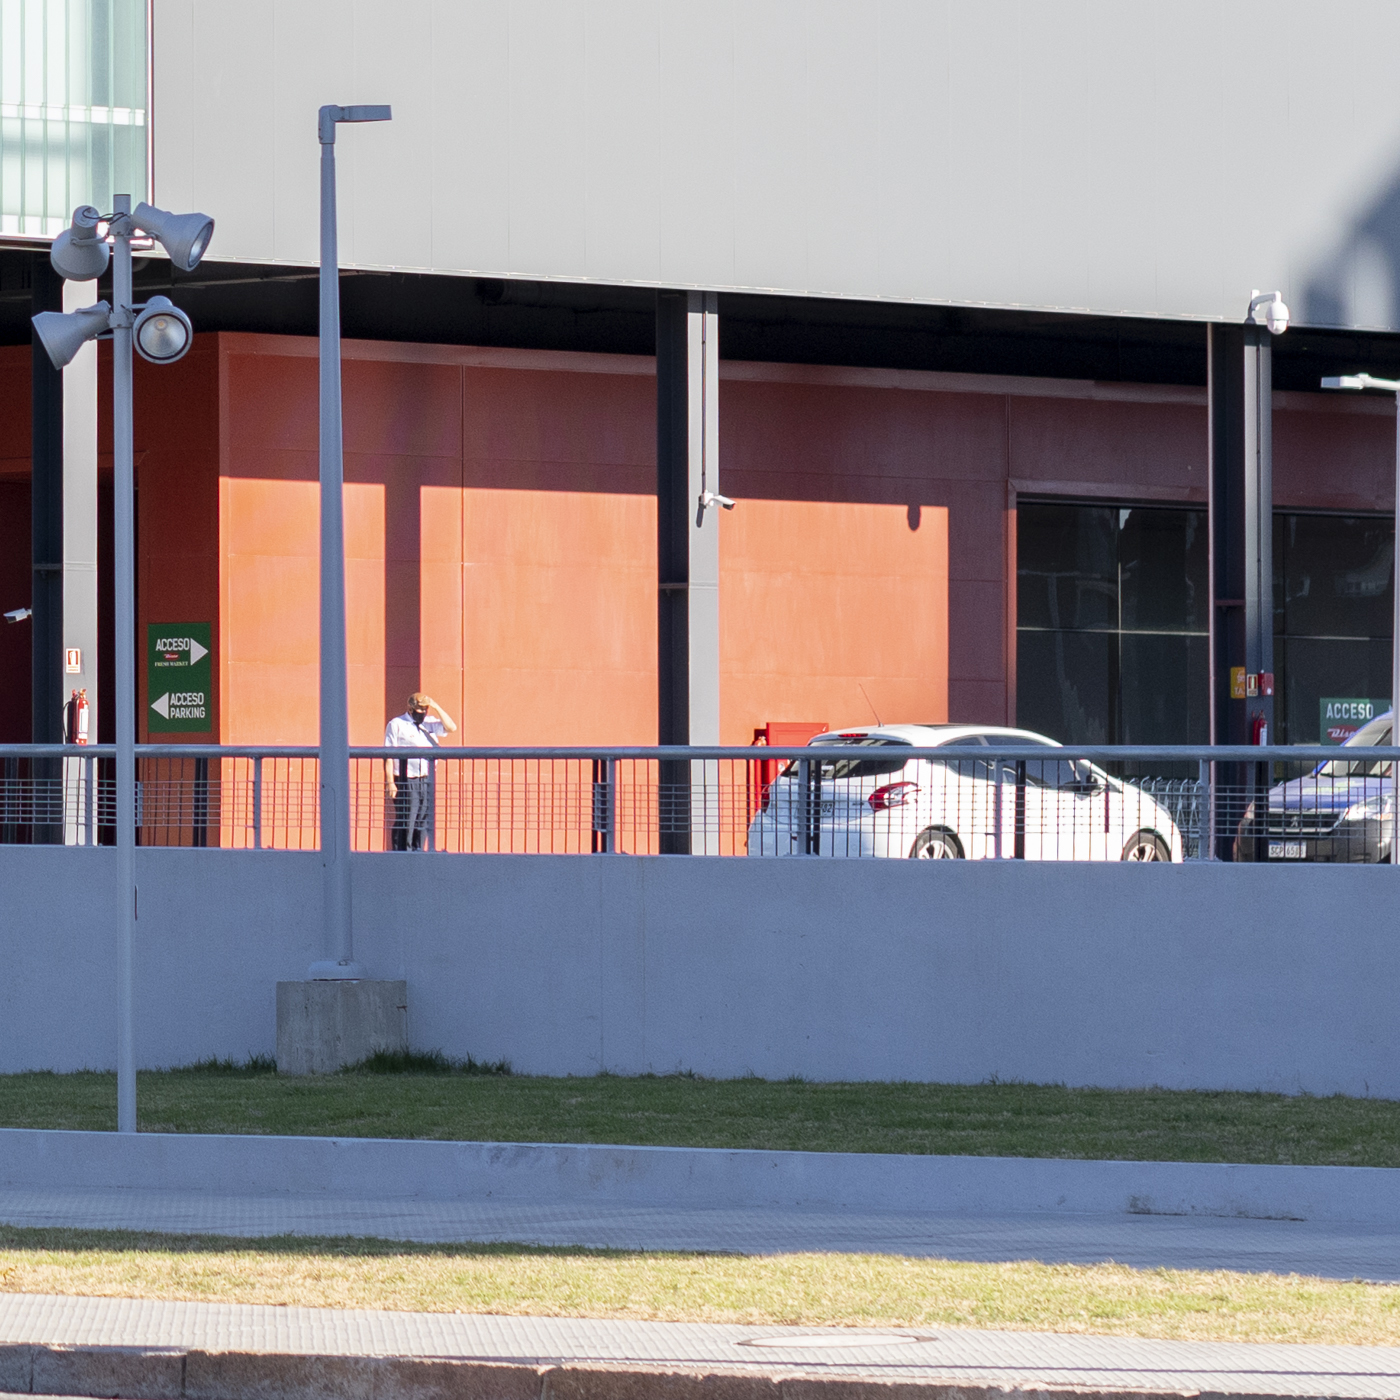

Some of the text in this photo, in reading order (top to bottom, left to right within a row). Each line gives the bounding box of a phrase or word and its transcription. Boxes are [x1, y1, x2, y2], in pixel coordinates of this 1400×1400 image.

[155, 638, 190, 651] ACCESO
[170, 692, 204, 706] ACCESO
[170, 706, 206, 719] PARKING
[1326, 702, 1374, 720] ACCESO
